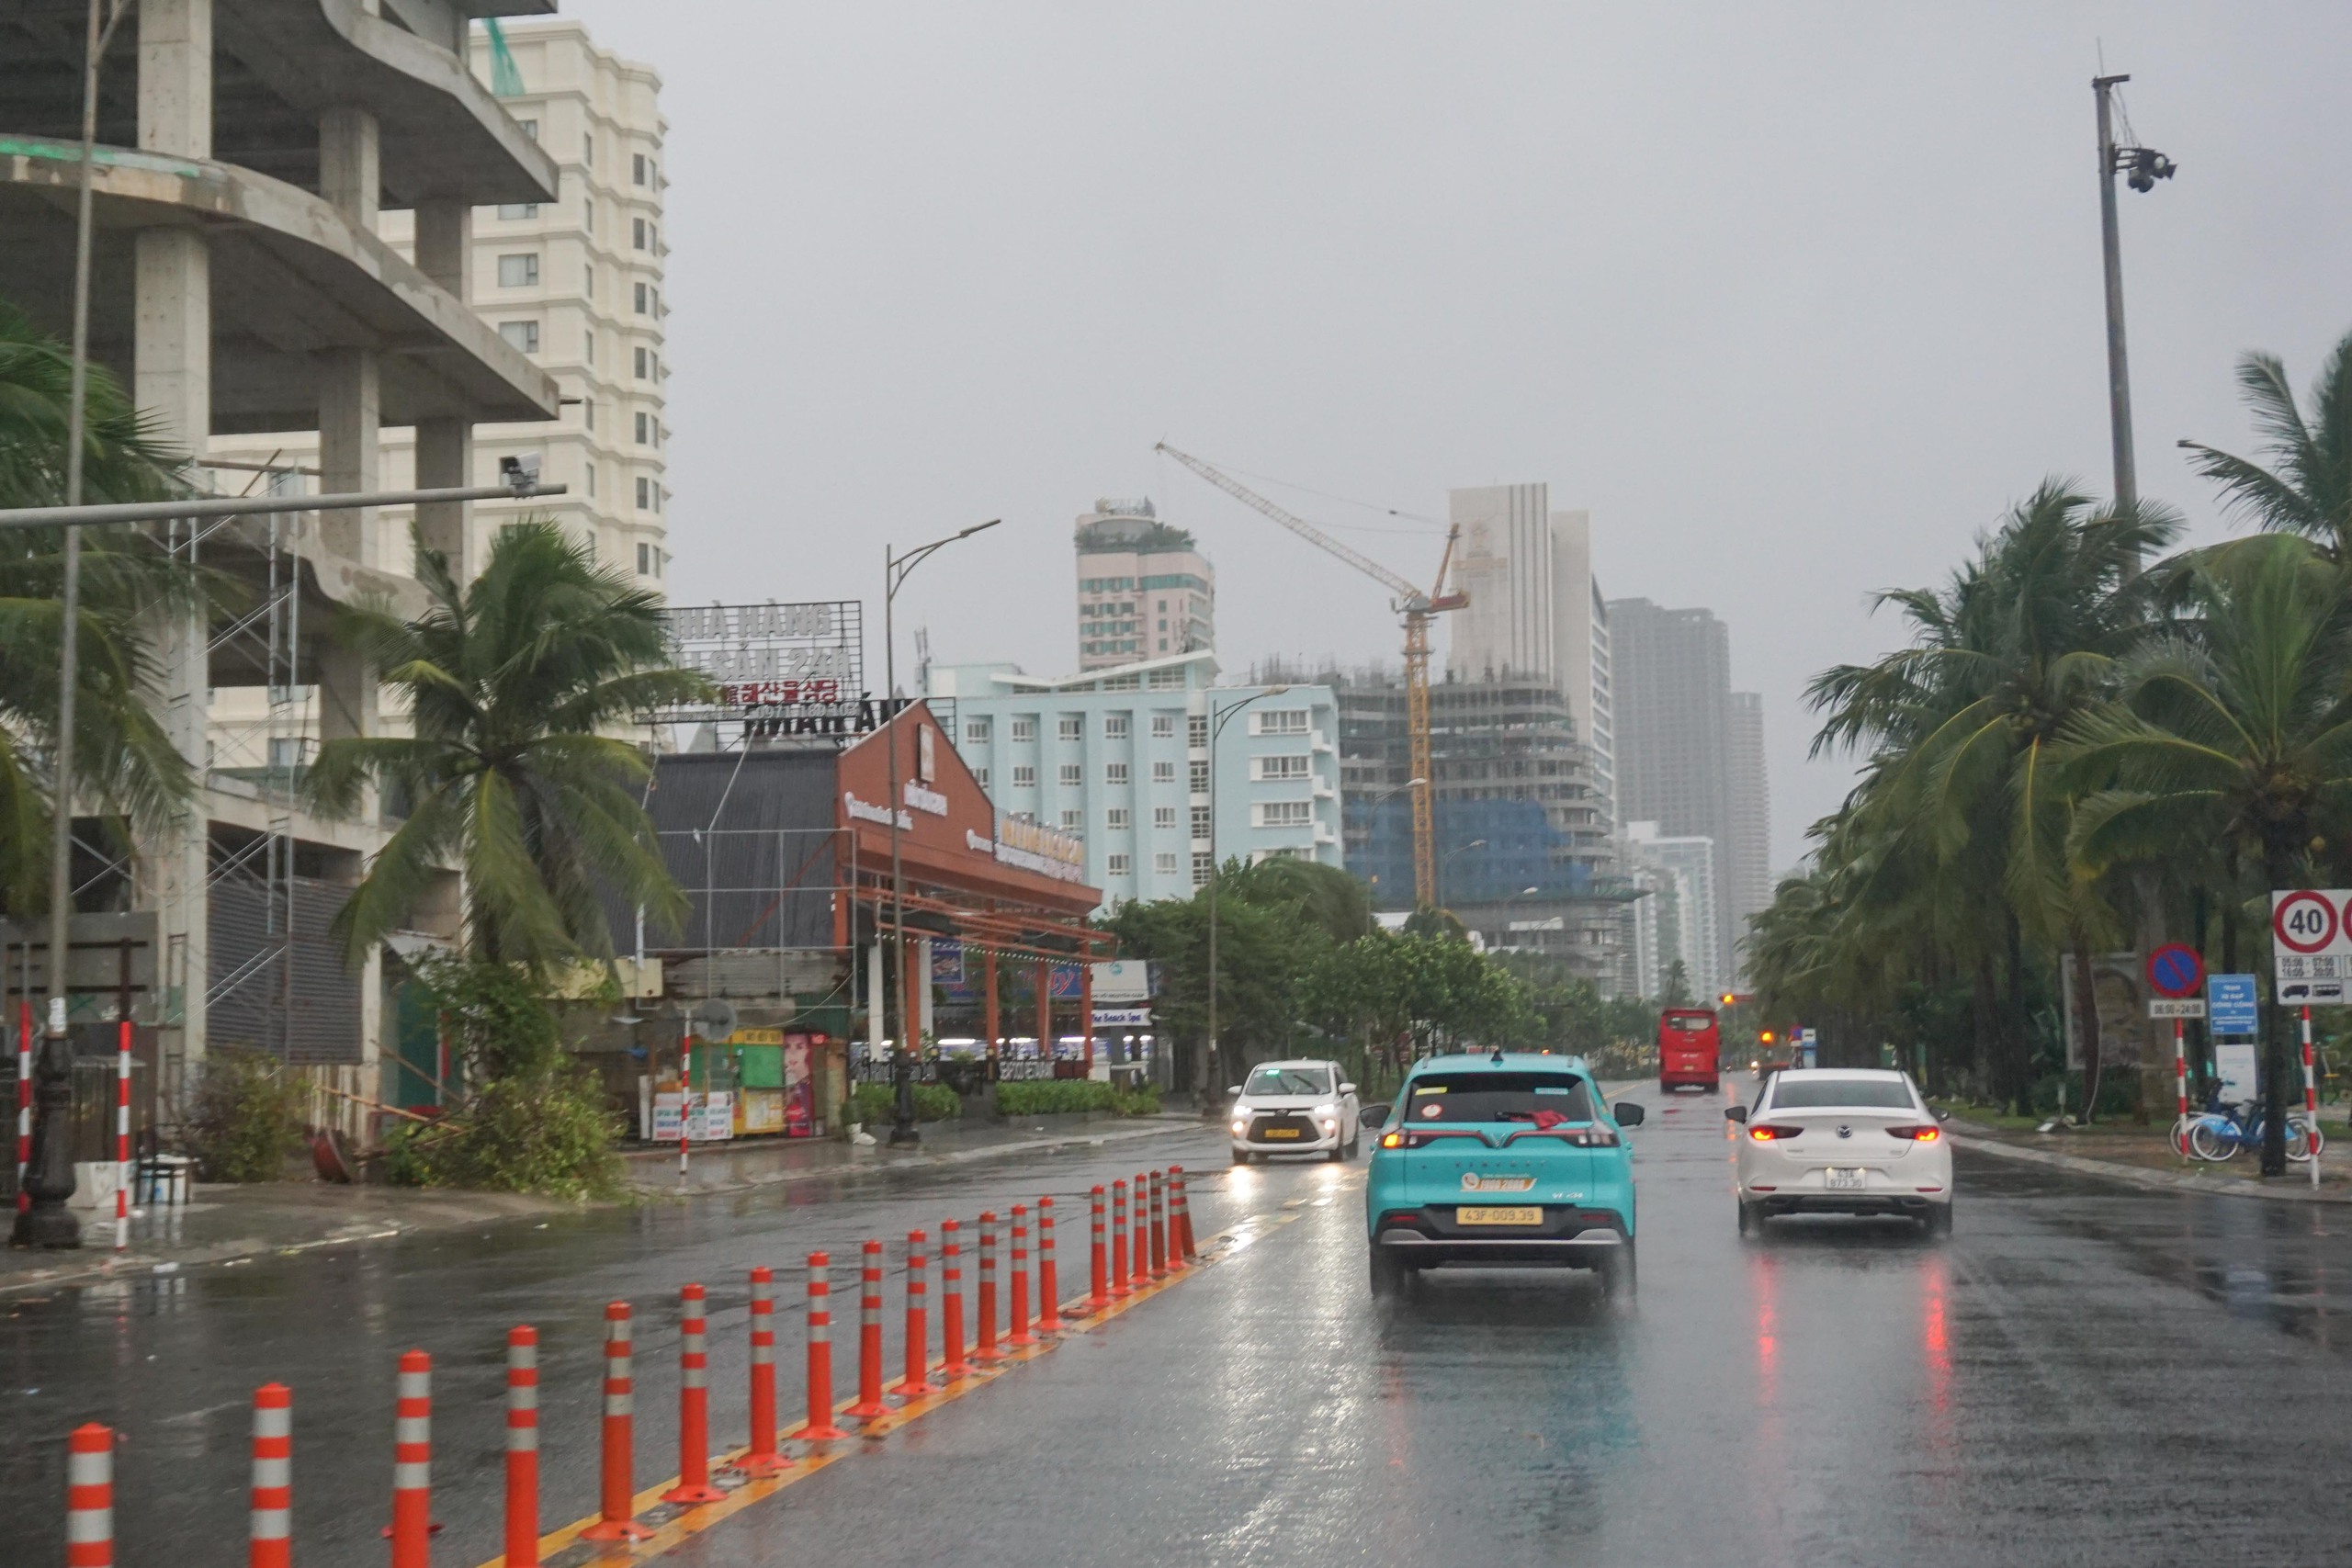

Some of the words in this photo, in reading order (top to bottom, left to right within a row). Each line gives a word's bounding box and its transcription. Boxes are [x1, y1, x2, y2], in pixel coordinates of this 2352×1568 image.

[738, 598, 831, 637] HÀNG
[710, 640, 780, 681] SẢN
[2290, 908, 2323, 934] 40
